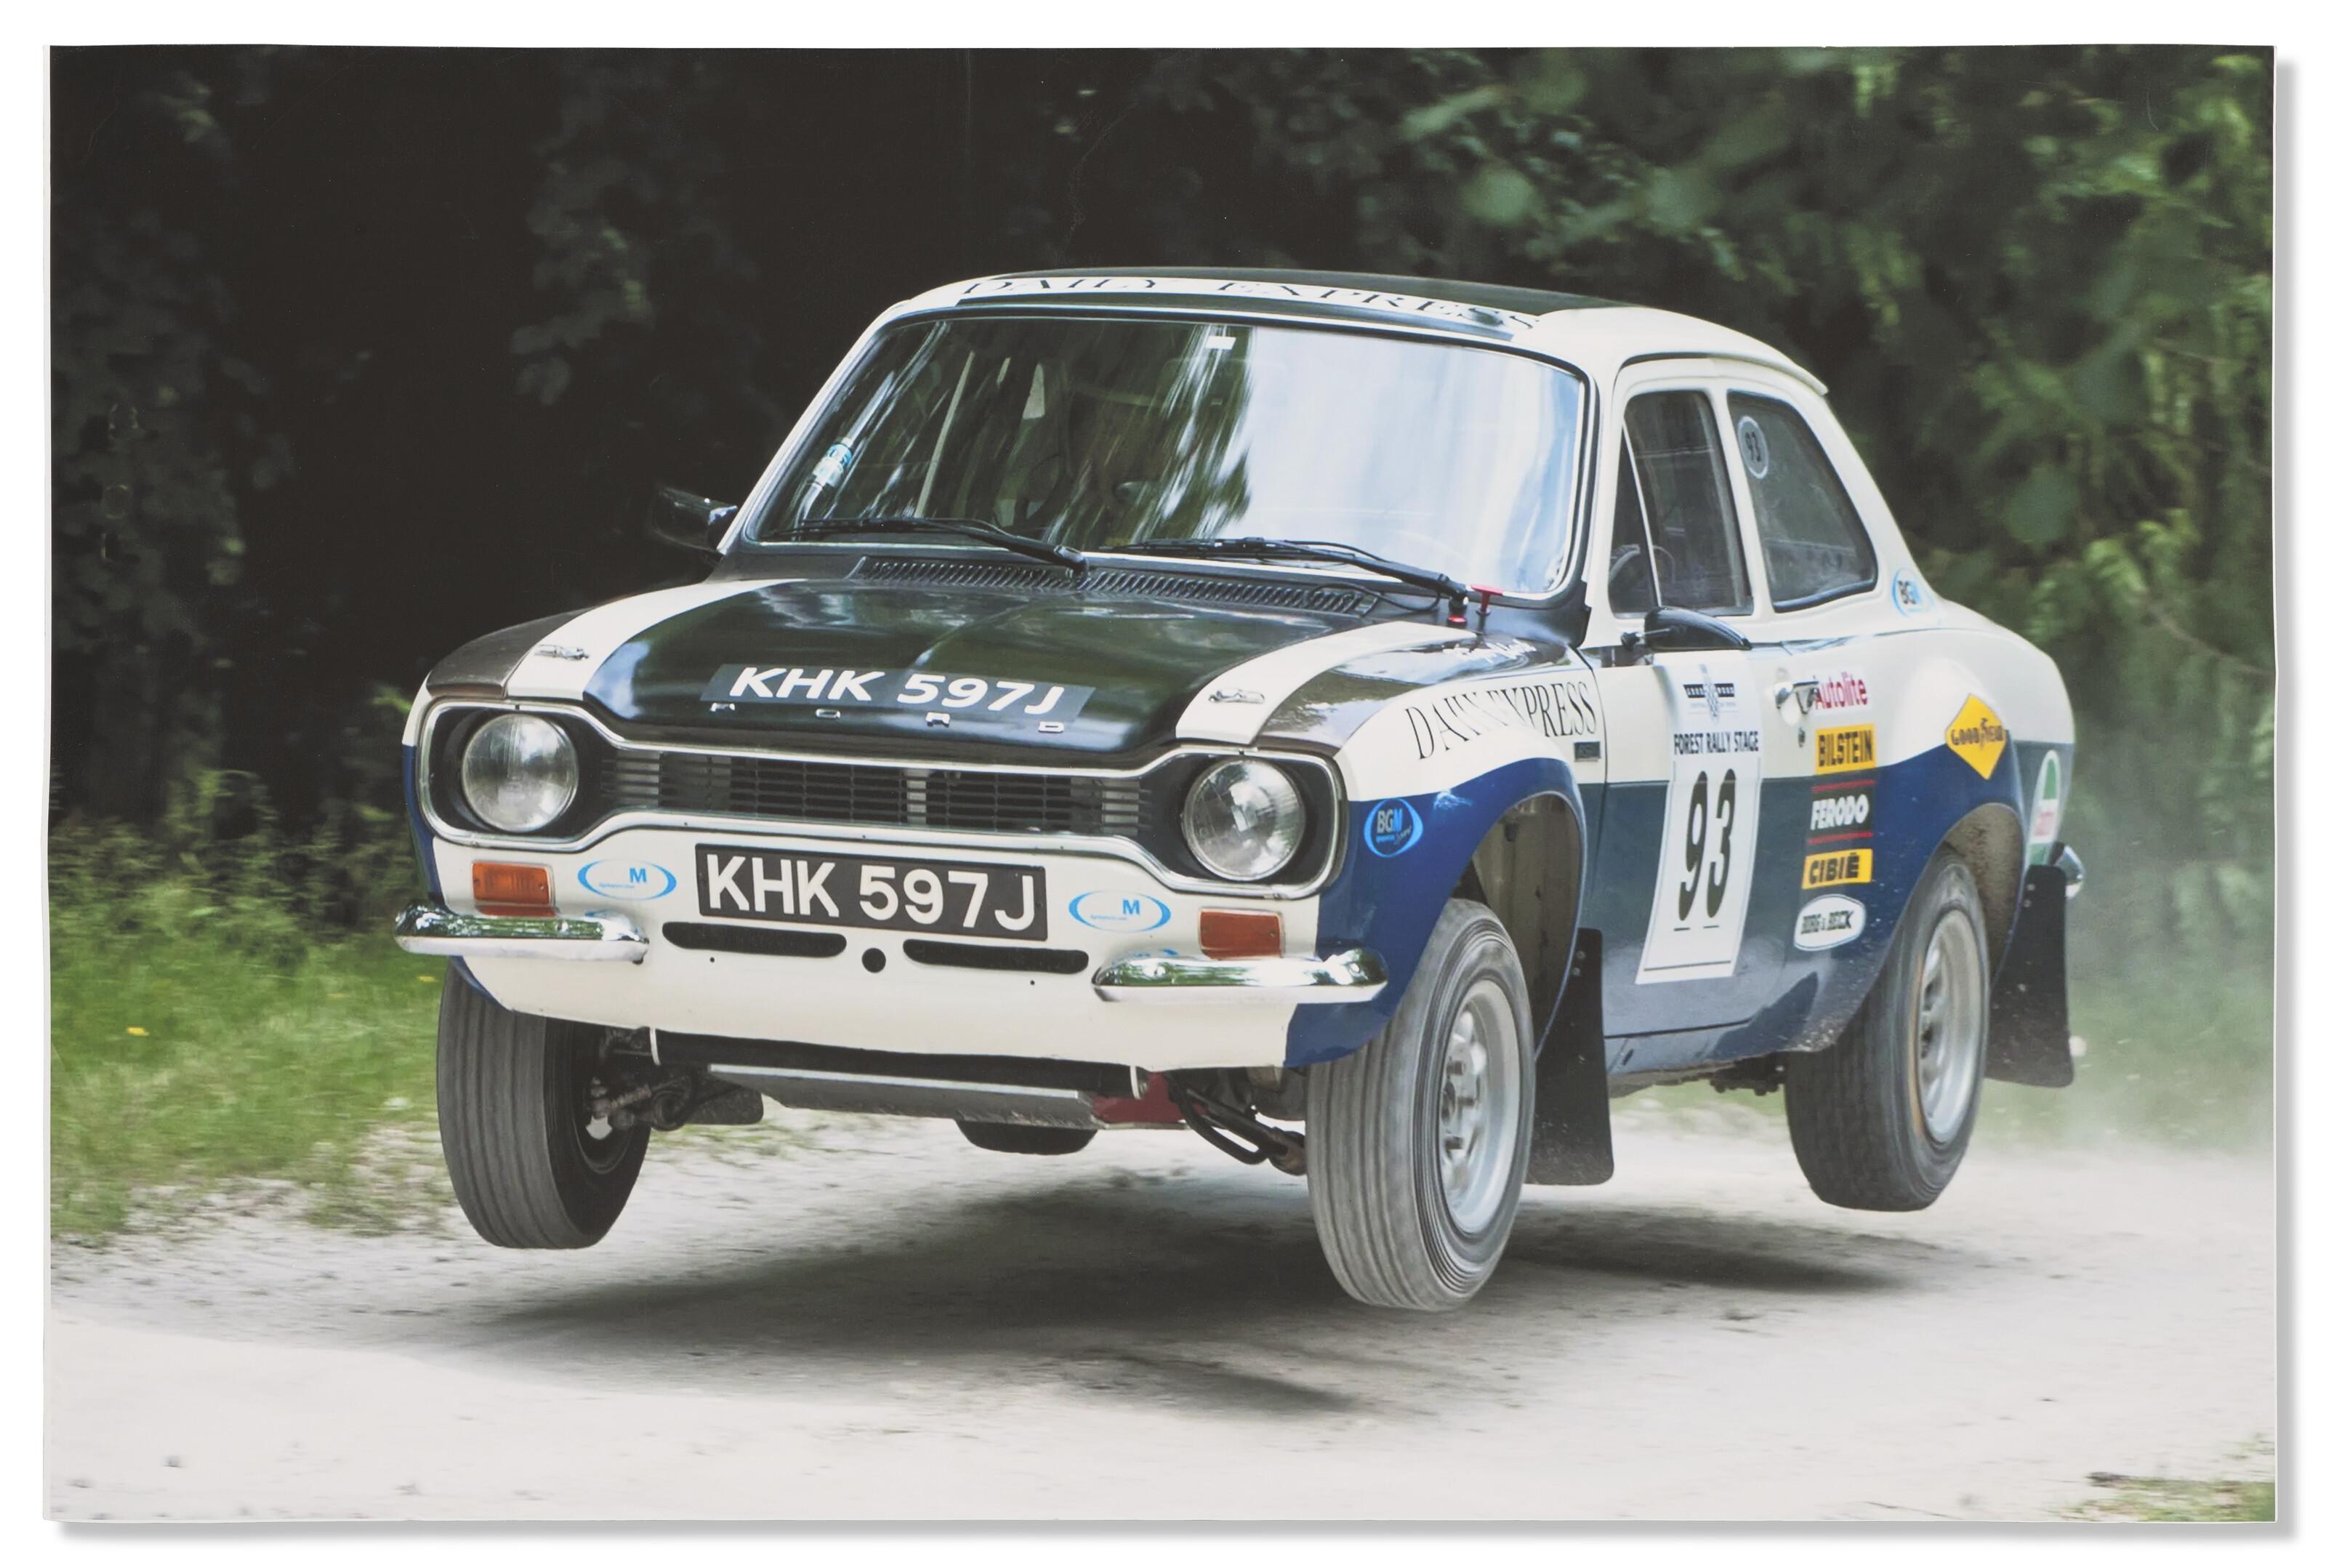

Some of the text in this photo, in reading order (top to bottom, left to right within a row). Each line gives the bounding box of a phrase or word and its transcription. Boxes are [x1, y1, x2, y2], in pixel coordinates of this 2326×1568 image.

[729, 667, 1065, 715] KHK 597J
[1673, 731, 1758, 755] FOREST RALLY STAGE
[1818, 730, 1873, 767] BILSTEIN
[1810, 794, 1869, 830] FERODO
[1678, 768, 1736, 921] 93
[707, 854, 1036, 932] KHK 597J
